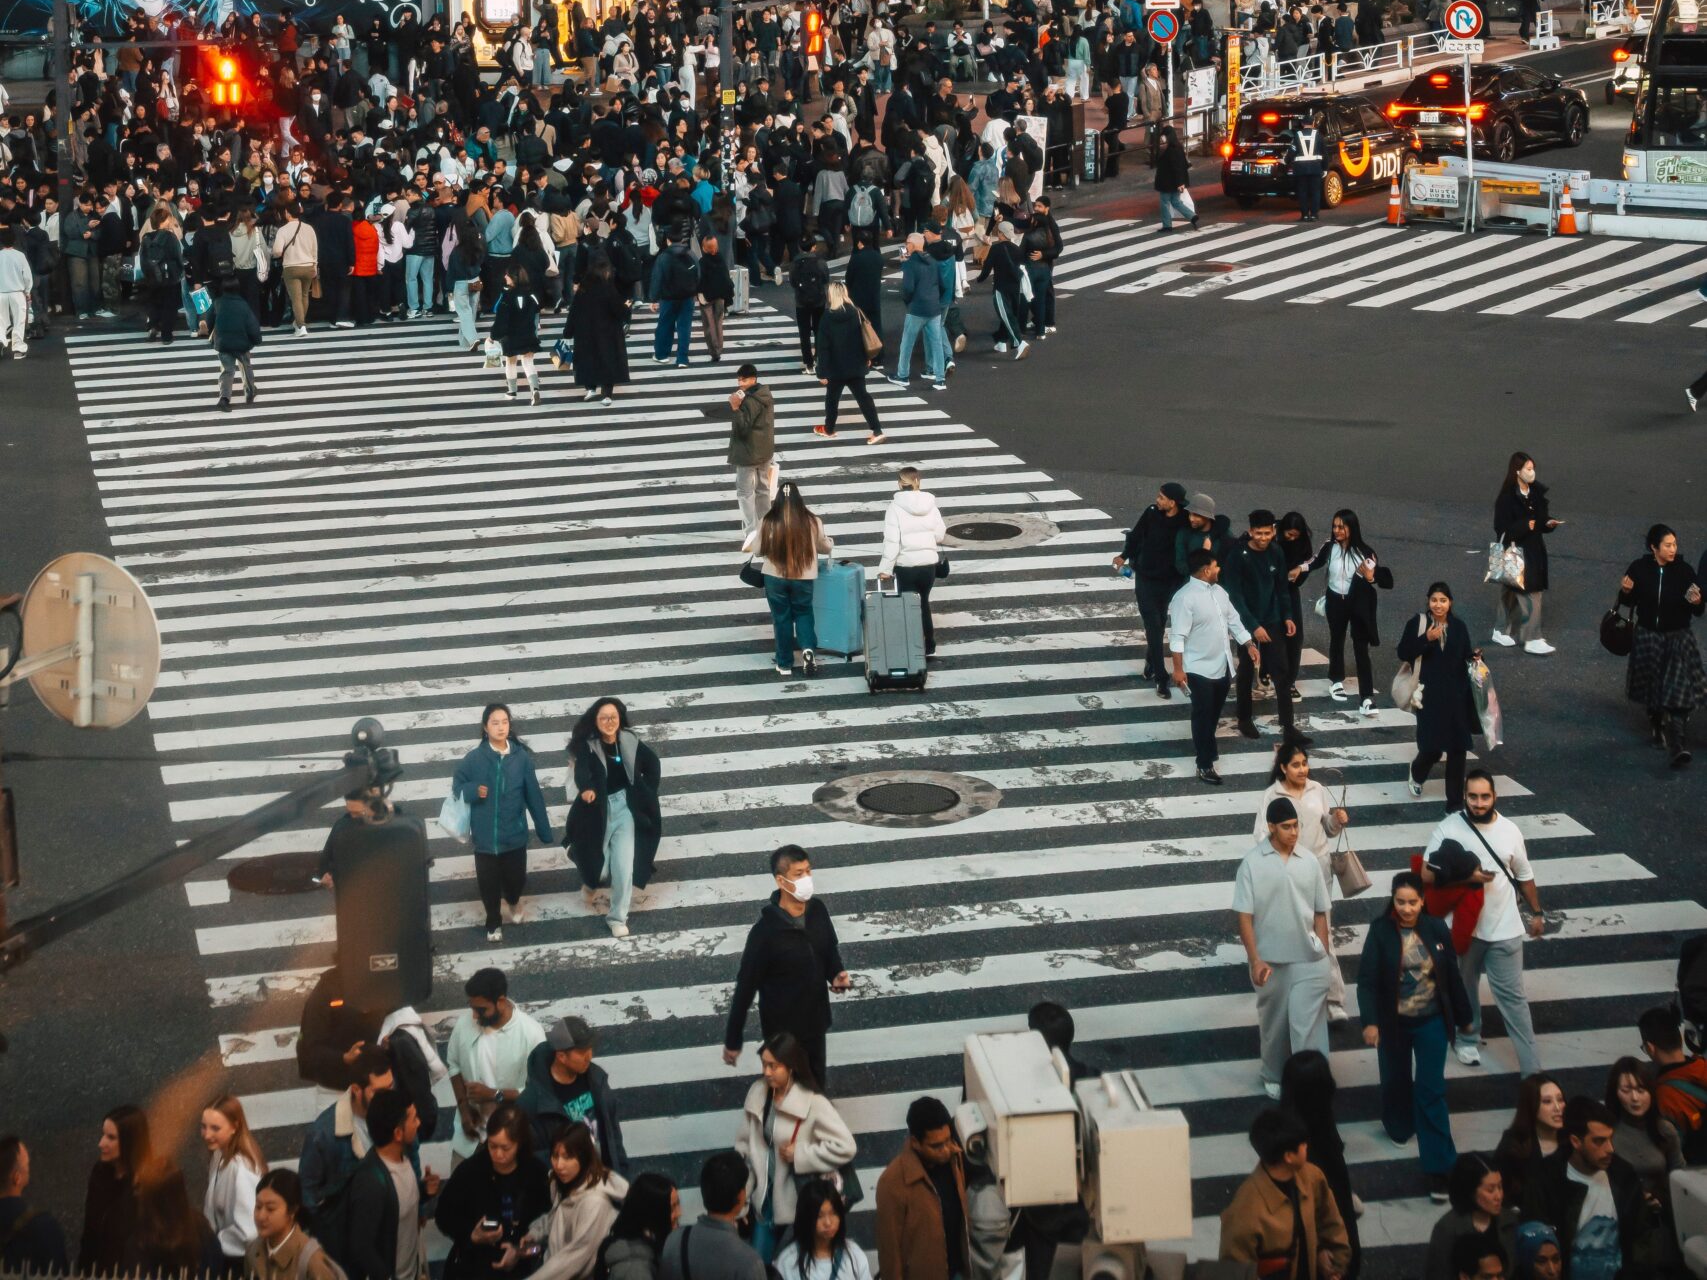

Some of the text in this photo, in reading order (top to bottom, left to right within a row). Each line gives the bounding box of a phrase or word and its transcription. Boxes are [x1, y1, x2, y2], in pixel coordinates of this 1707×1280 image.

[1449, 42, 1481, 52] ここまで
[1373, 149, 1400, 180] DiDi
